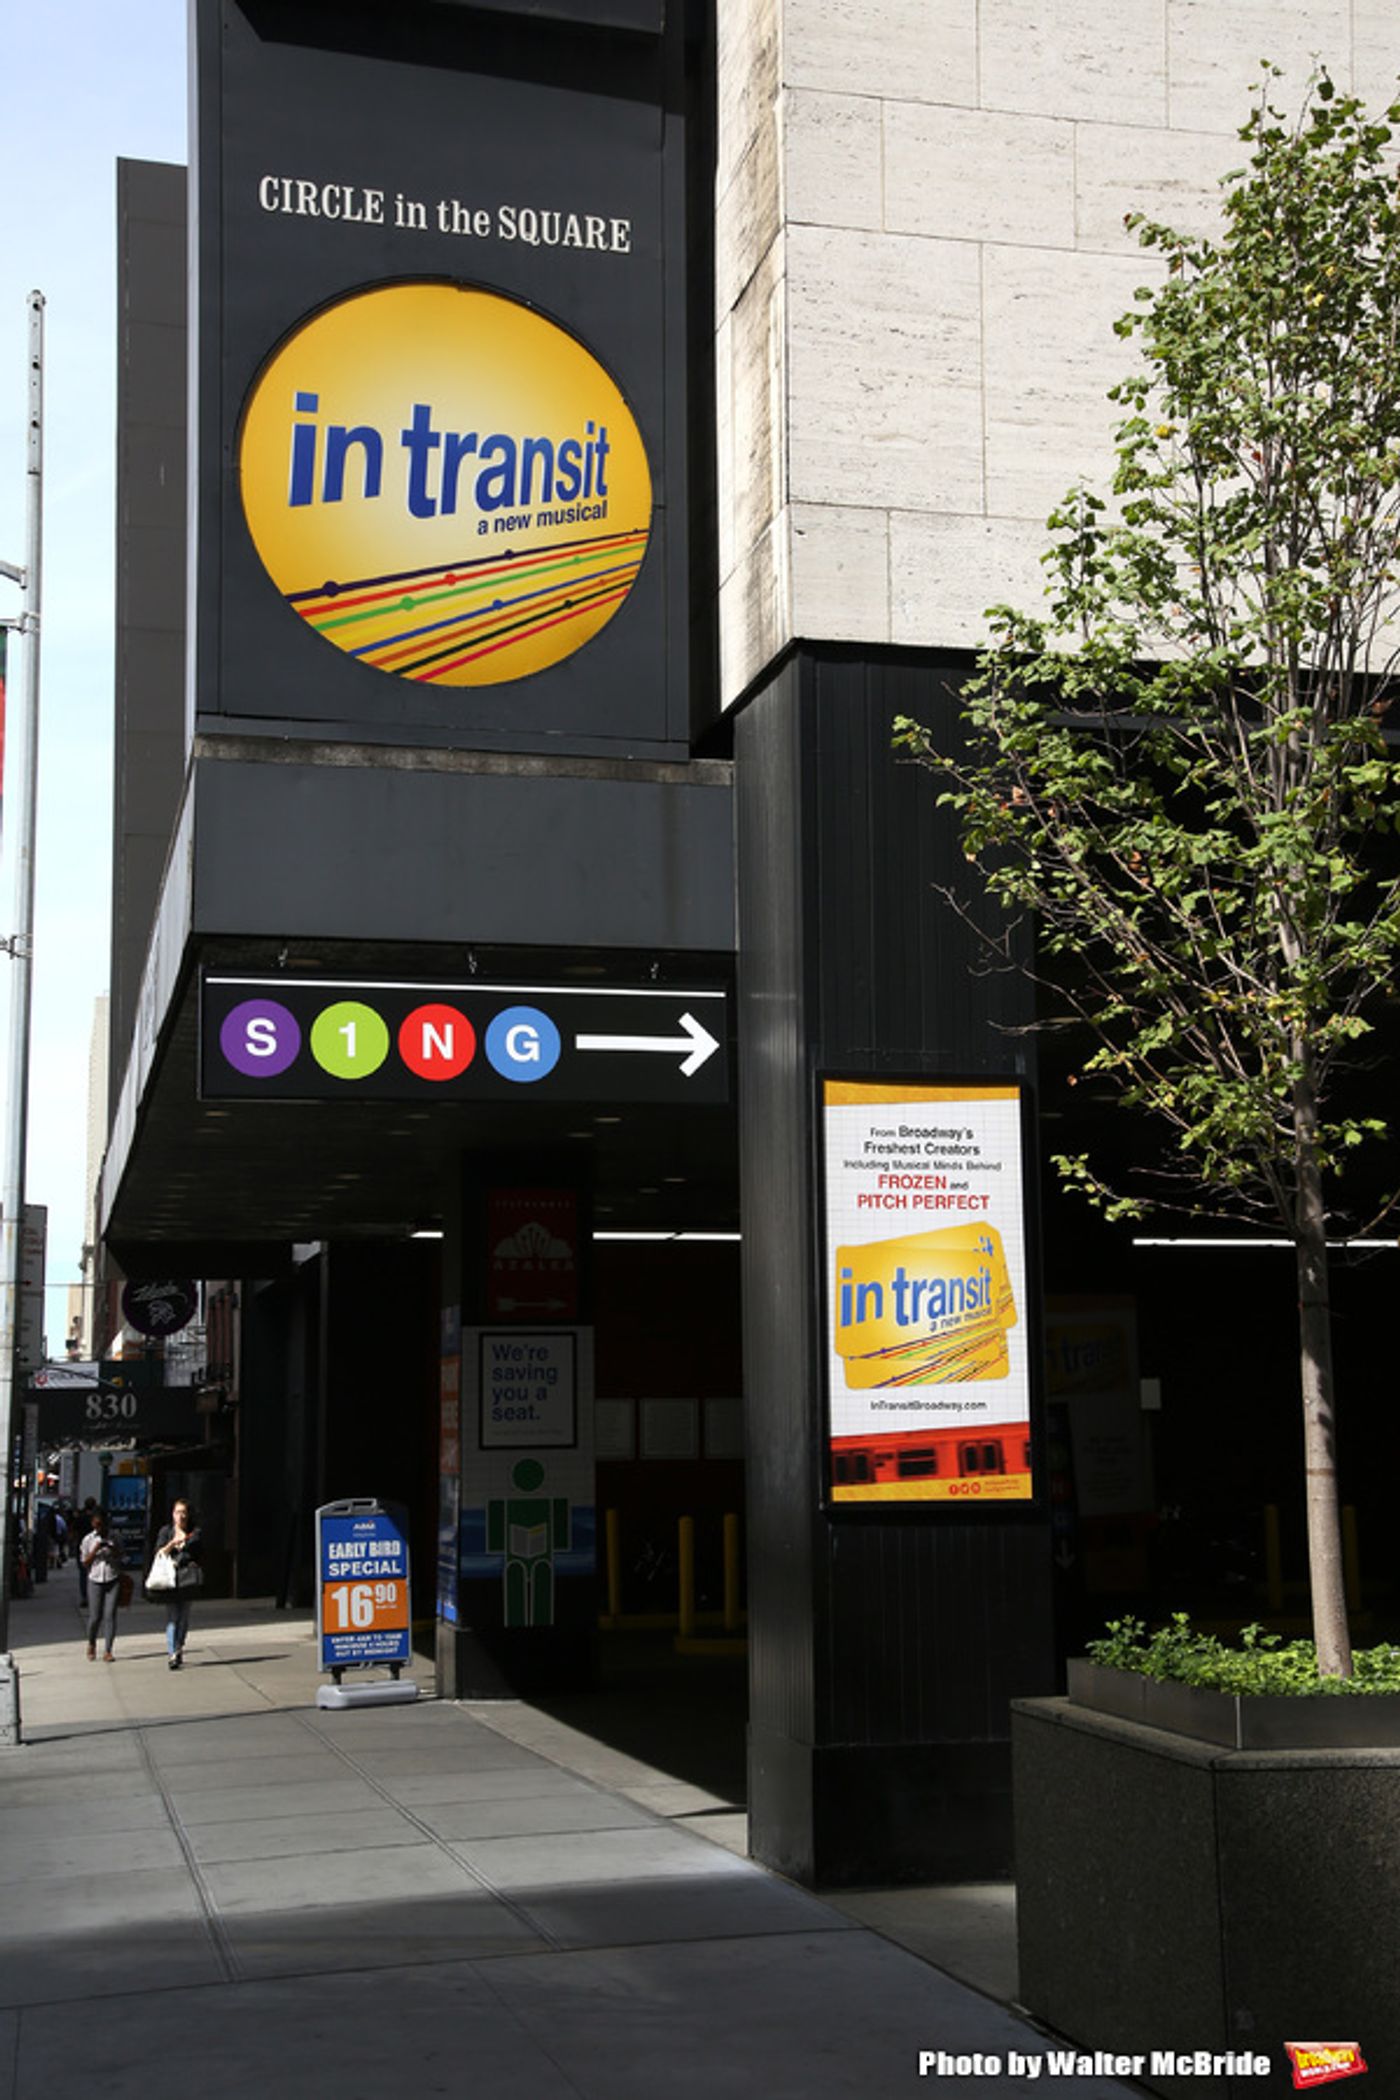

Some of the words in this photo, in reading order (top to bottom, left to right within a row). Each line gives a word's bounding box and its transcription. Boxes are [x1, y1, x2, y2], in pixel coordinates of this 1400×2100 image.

[258, 175, 385, 225] CIRCLE
[394, 193, 428, 230] in
[437, 200, 491, 238] the
[498, 206, 631, 253] SQUARE
[288, 391, 384, 508] in
[401, 403, 611, 518] transit
[477, 518, 489, 536] a
[494, 513, 532, 534] new
[536, 500, 608, 528] musical
[245, 1017, 278, 1057] S
[338, 1021, 357, 1058] 1
[421, 1022, 454, 1060] N
[505, 1024, 539, 1062] G
[870, 1128, 897, 1138] From
[898, 1125, 974, 1141] Broadway's
[864, 1141, 921, 1154] Freshest
[924, 1141, 980, 1155] Creators
[844, 1160, 890, 1172] Including
[892, 1160, 930, 1170] Musical
[933, 1161, 963, 1171] Minds
[966, 1162, 1002, 1171] Behind
[878, 1174, 947, 1190] FROZEN
[950, 1181, 969, 1190] and
[857, 1194, 907, 1209] PITCH
[912, 1194, 990, 1210] PERFECT
[840, 1268, 884, 1327] in
[891, 1265, 992, 1326] transit
[929, 1321, 937, 1332] a
[940, 1315, 962, 1328] new
[491, 1343, 550, 1361] We're
[491, 1363, 559, 1386] saving
[491, 1387, 529, 1406] you
[536, 1387, 547, 1401] a
[85, 1393, 138, 1420] 830
[491, 1405, 541, 1421] seat.
[870, 1401, 988, 1412] InTransitBroadway.com
[328, 1541, 367, 1560] EARLY
[369, 1540, 401, 1557] BIRD
[328, 1559, 402, 1577] SPECIAL
[331, 1583, 374, 1628] 16
[374, 1583, 397, 1604] 90
